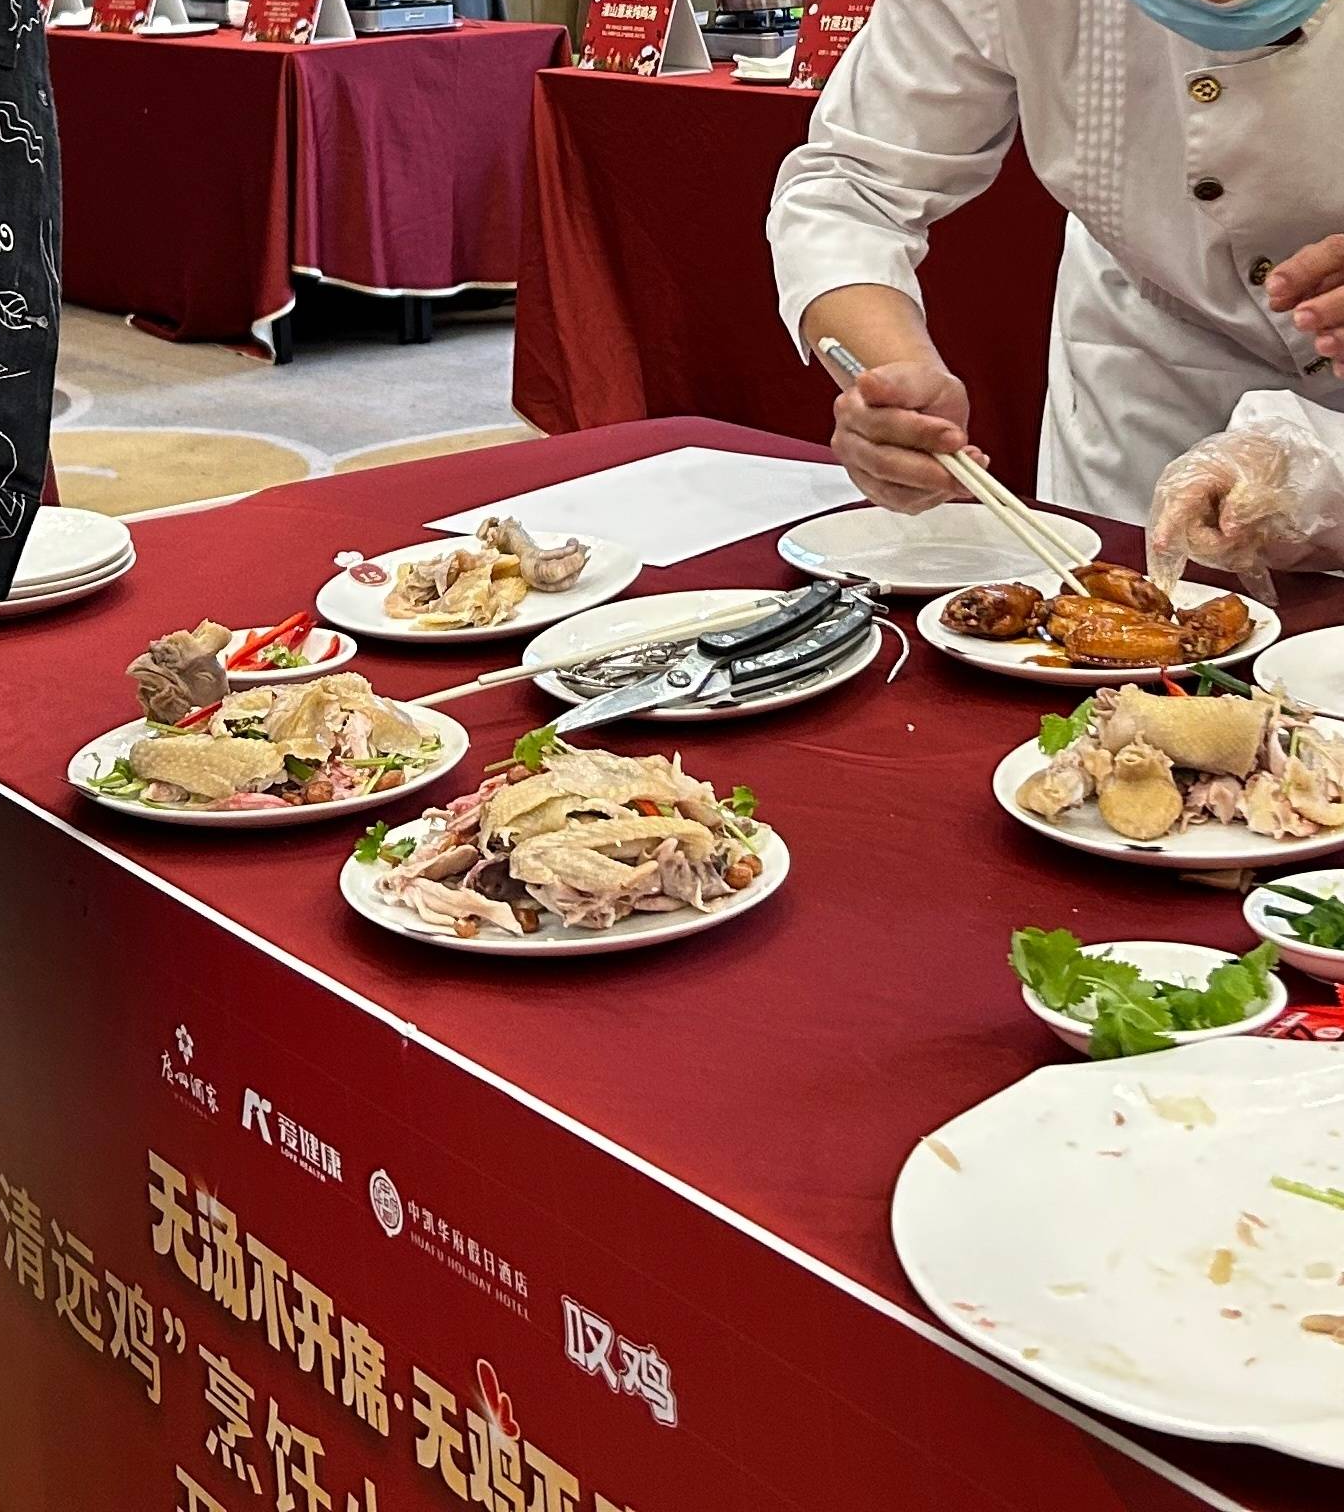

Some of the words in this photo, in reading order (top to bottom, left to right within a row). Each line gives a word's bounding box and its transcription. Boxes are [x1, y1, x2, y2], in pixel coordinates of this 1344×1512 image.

[276, 1110, 344, 1183] 爱健康
[407, 1198, 529, 1299] 中凯华府假日酒店
[446, 1254, 492, 1296] HOLIDAY
[148, 1148, 638, 1512] 无汤不开席·无鸡不
[561, 1294, 679, 1429] 叹鸡
